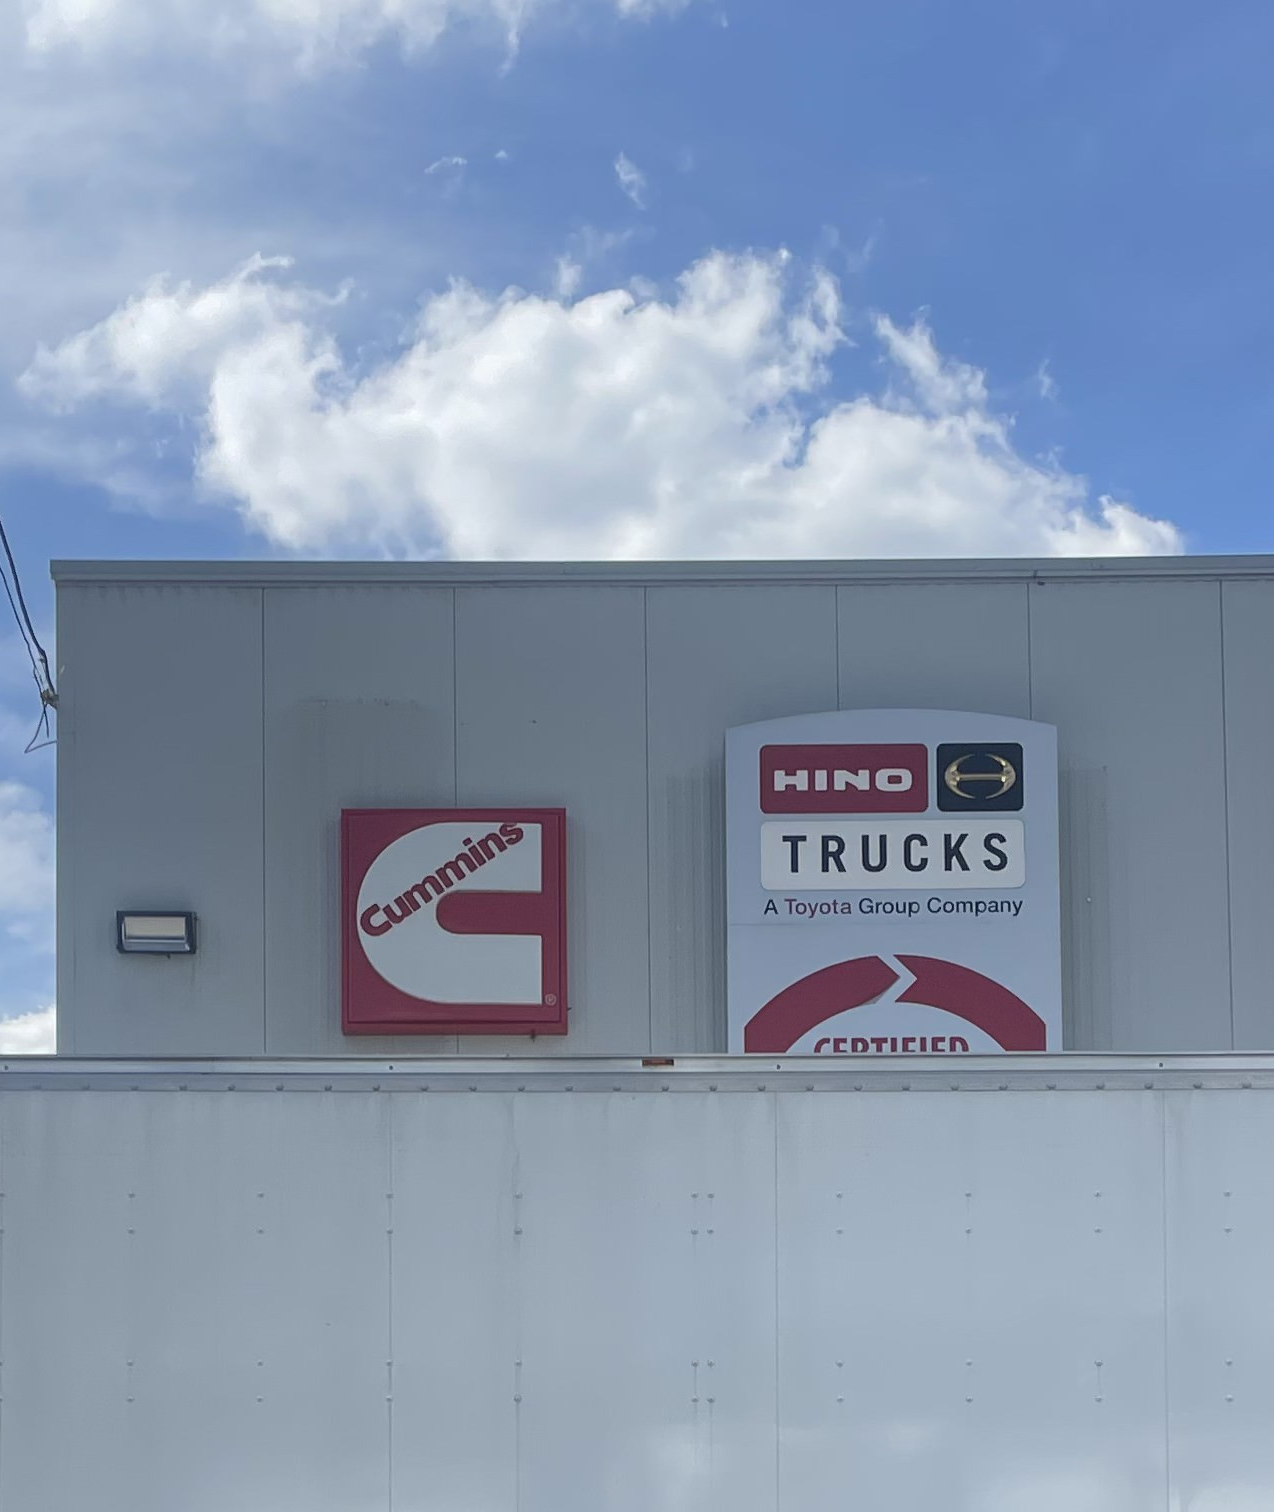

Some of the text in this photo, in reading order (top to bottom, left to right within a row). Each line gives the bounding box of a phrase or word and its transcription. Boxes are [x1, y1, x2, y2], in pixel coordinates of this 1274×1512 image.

[773, 768, 913, 792] HINO
[782, 832, 1009, 874] TRUCKS
[360, 821, 524, 937] Cummins
[763, 896, 1024, 919] A Toyota Group Company
